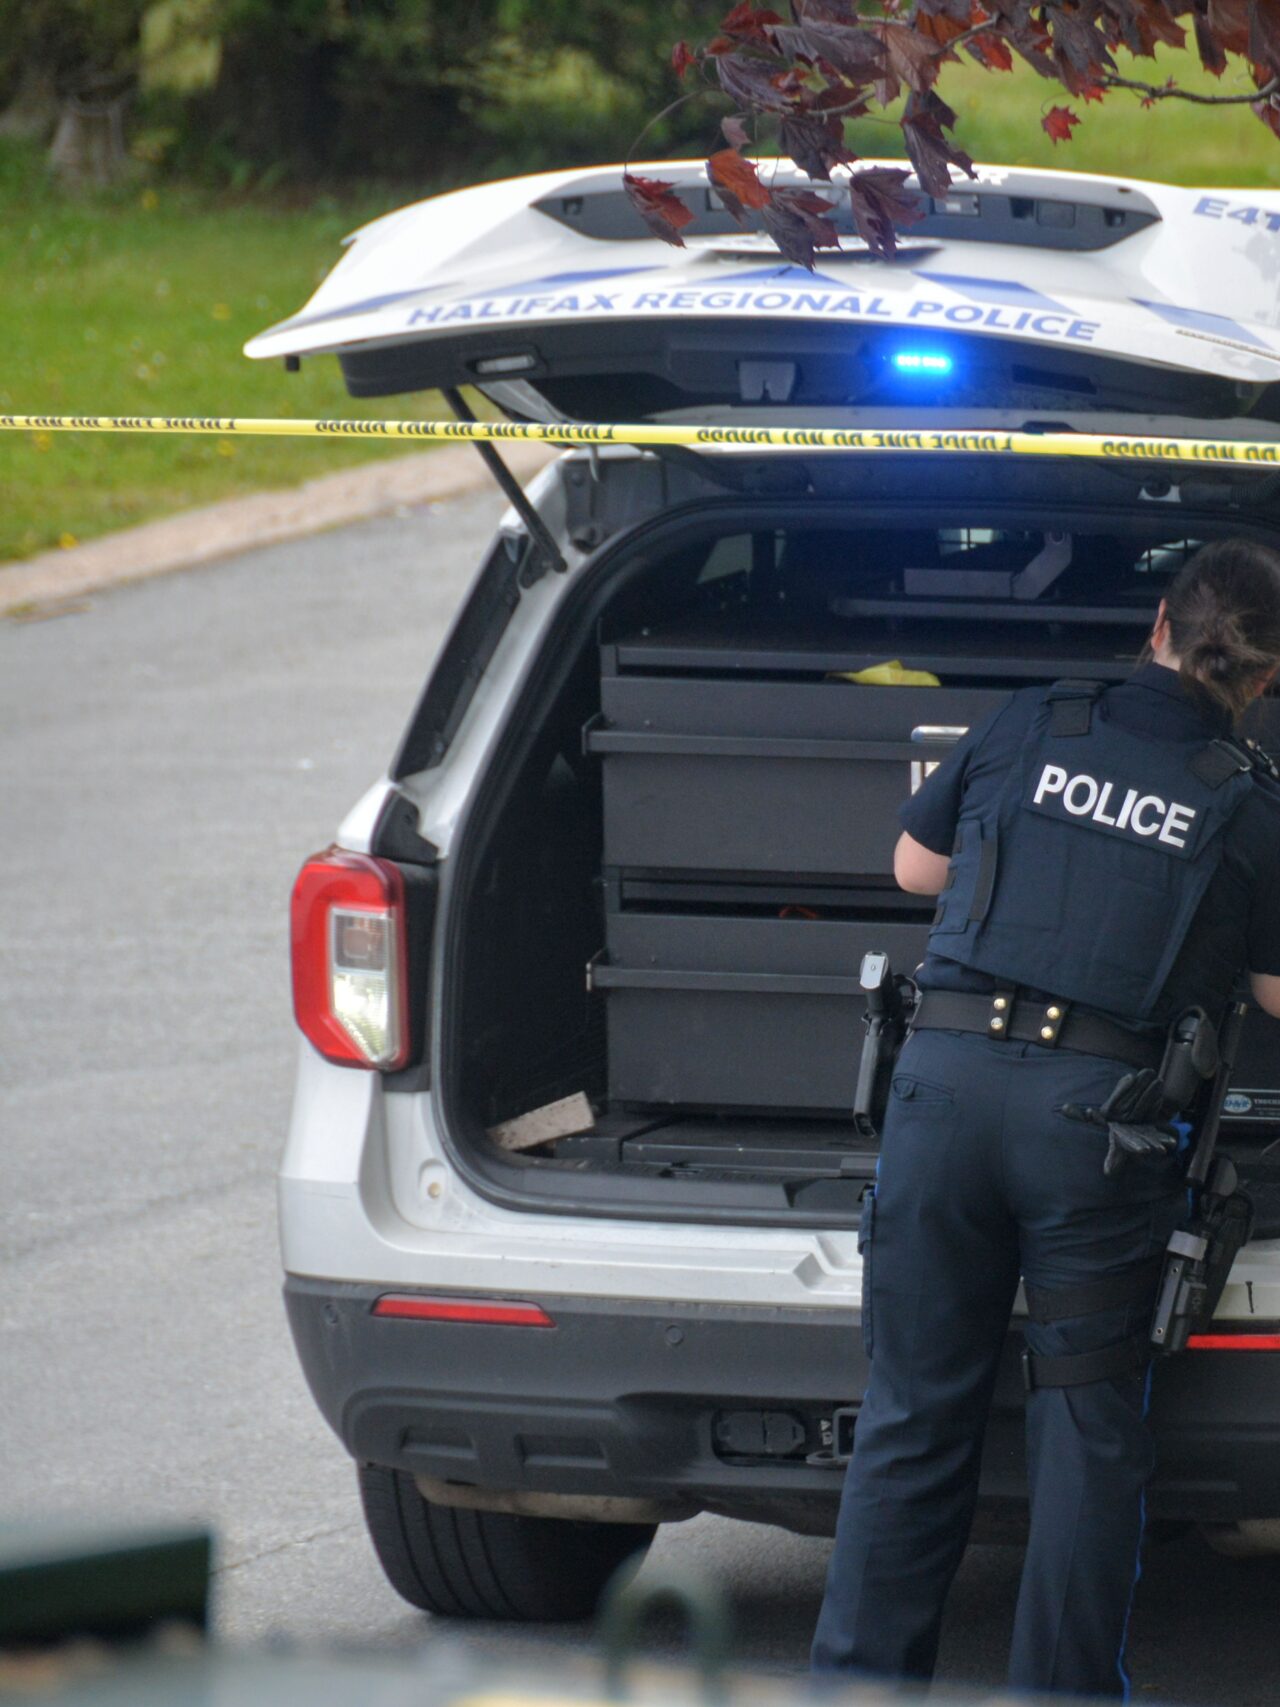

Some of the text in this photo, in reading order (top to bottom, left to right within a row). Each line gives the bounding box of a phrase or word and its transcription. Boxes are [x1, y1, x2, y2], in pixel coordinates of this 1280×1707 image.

[407, 292, 1101, 341] HALIFAX REGIONAL POLICE
[1033, 764, 1196, 848] POLICE
